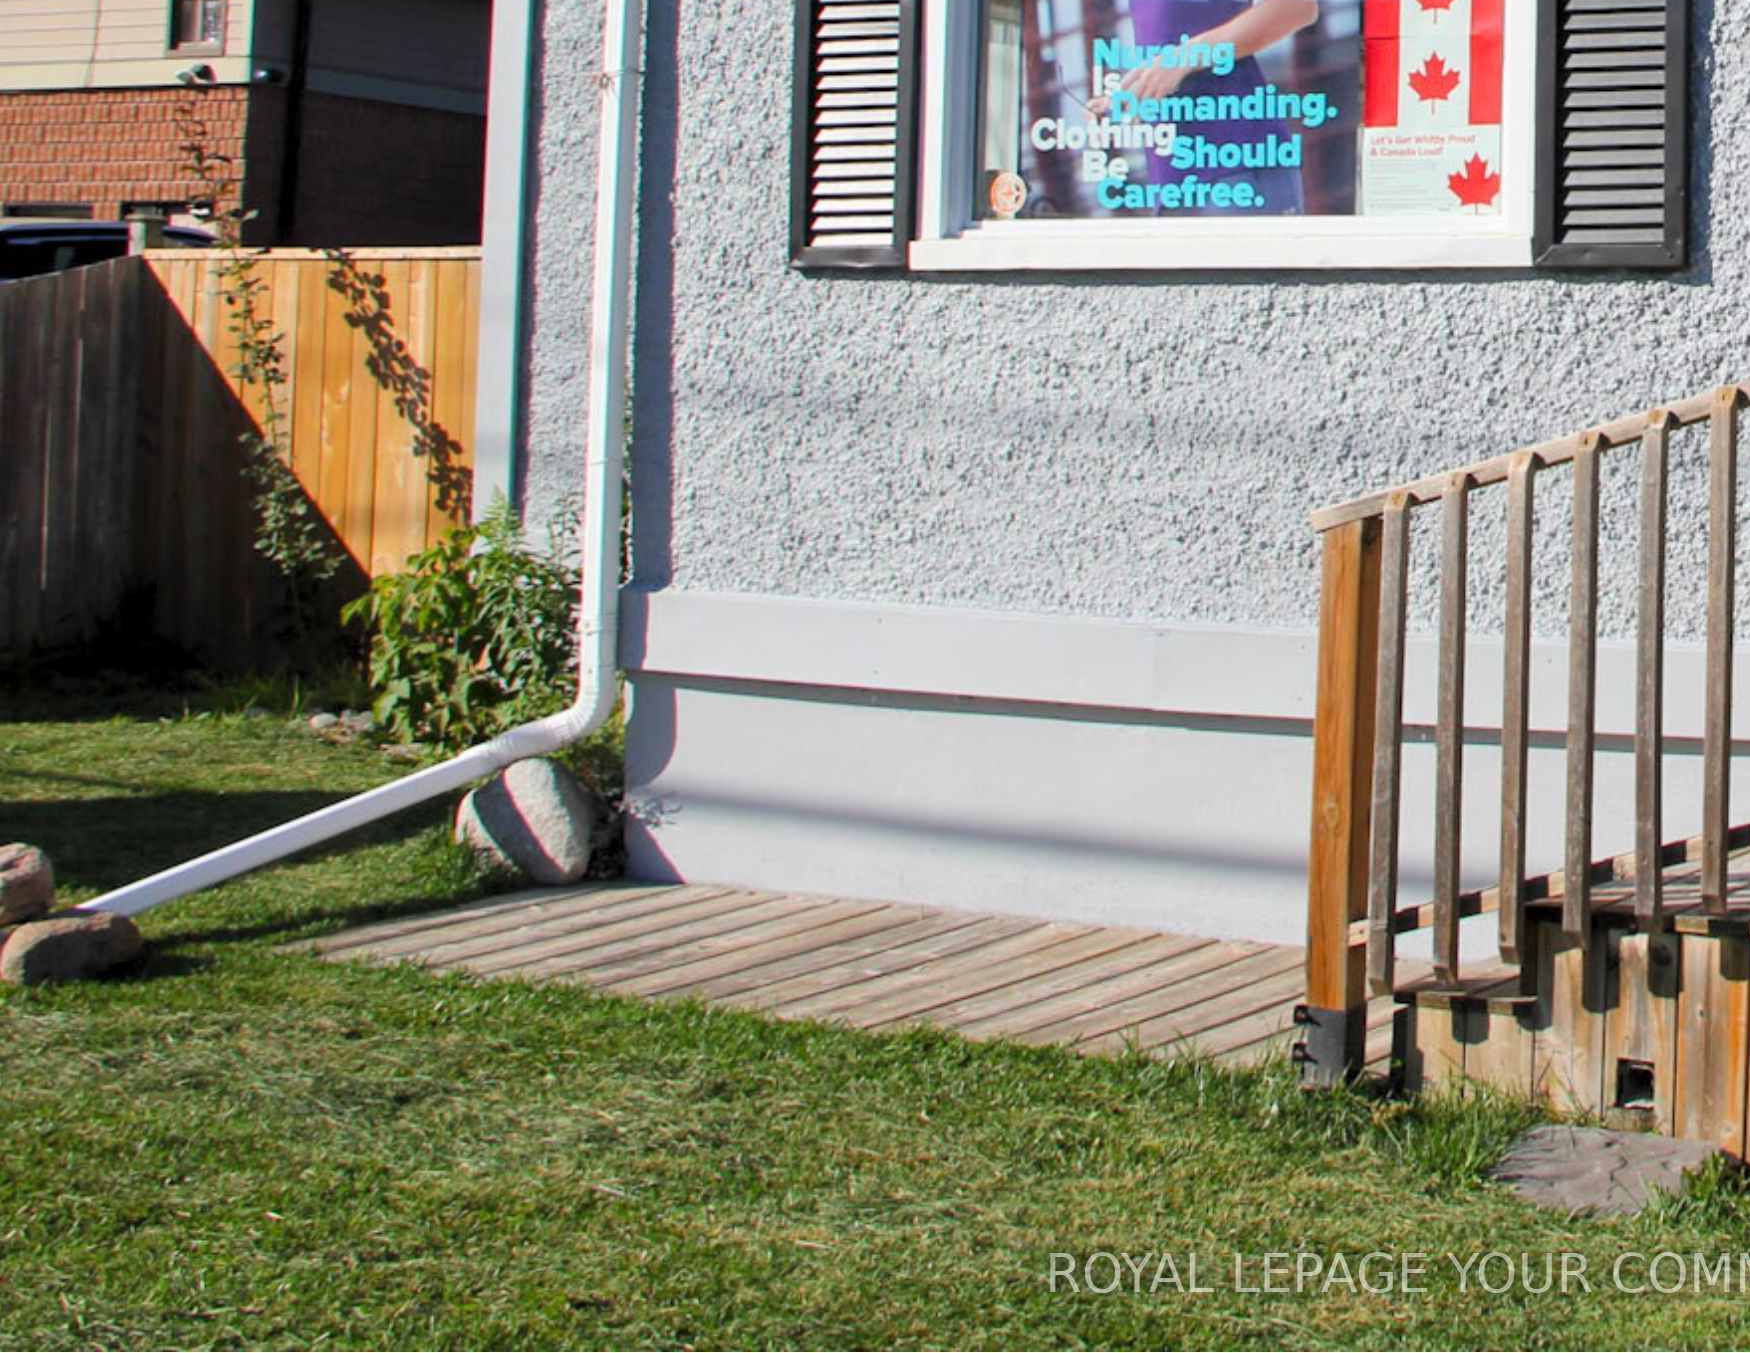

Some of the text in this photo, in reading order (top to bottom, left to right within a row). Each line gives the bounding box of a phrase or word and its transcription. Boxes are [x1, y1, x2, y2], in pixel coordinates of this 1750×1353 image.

[1093, 33, 1235, 76] Nursing
[1093, 65, 1121, 97] Is
[1111, 84, 1338, 128] Demanding.
[1030, 115, 1177, 157] Clothing
[1170, 134, 1303, 169] Should
[1082, 151, 1130, 183] Be
[1098, 175, 1265, 210] Carefree.
